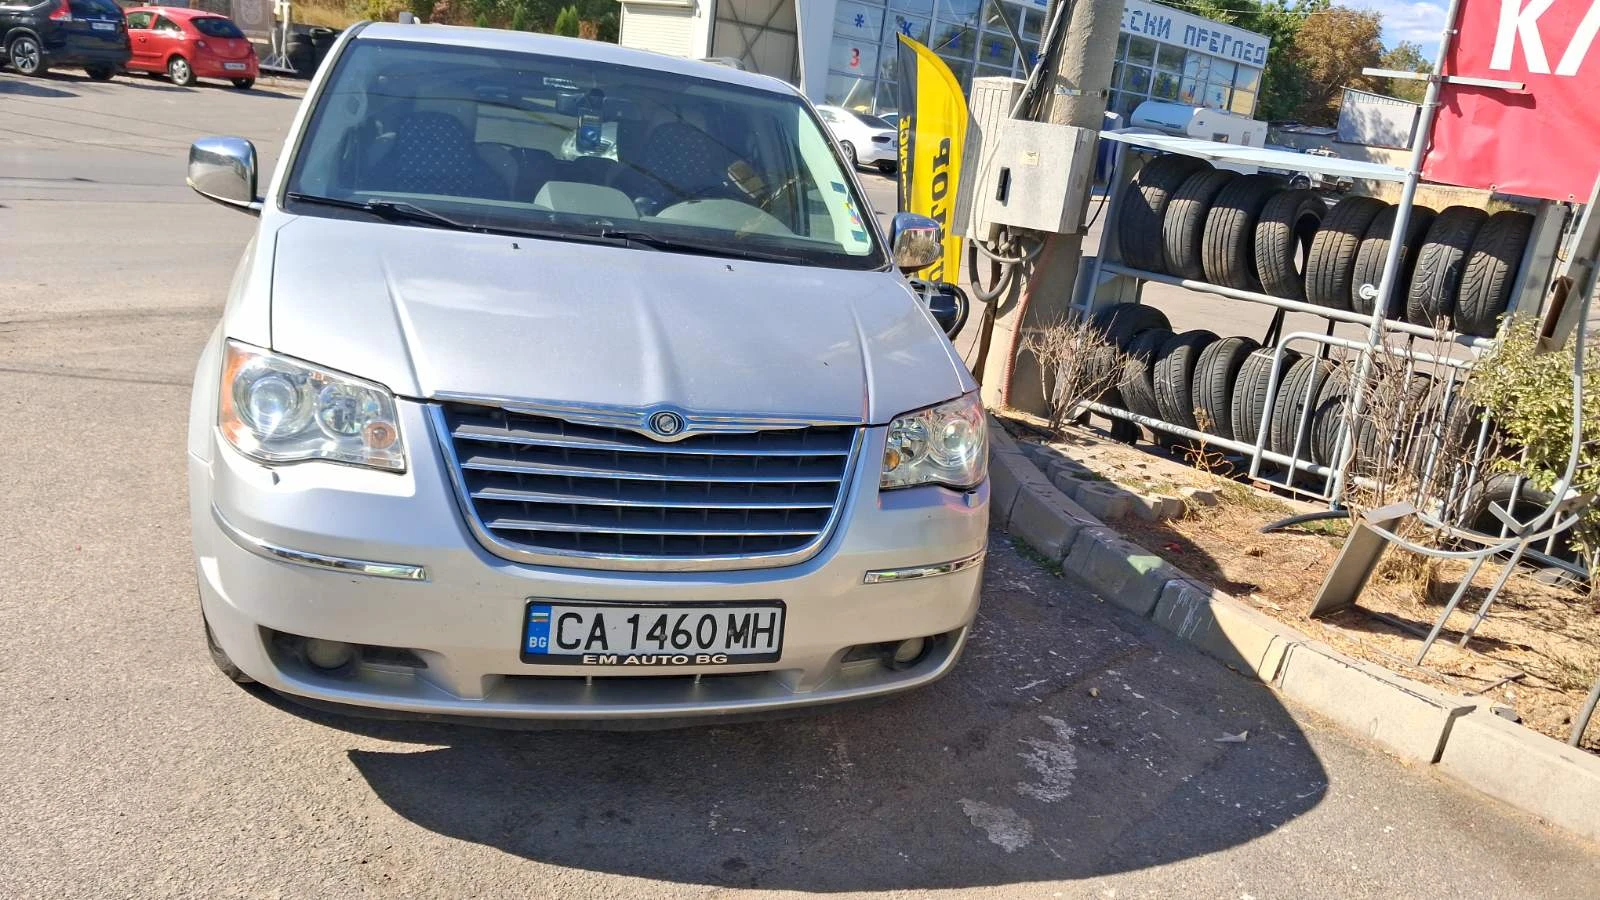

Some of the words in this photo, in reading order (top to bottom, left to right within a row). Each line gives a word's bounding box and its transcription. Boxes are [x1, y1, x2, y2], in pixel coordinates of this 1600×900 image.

[1184, 24, 1265, 65] ПРЕГЛЕД
[528, 636, 548, 649] BG
[556, 612, 609, 650] CA
[626, 613, 718, 650] 1460
[725, 612, 777, 649] MH
[582, 654, 617, 666] EM
[623, 654, 690, 666] AUTO
[695, 653, 728, 665] BG
